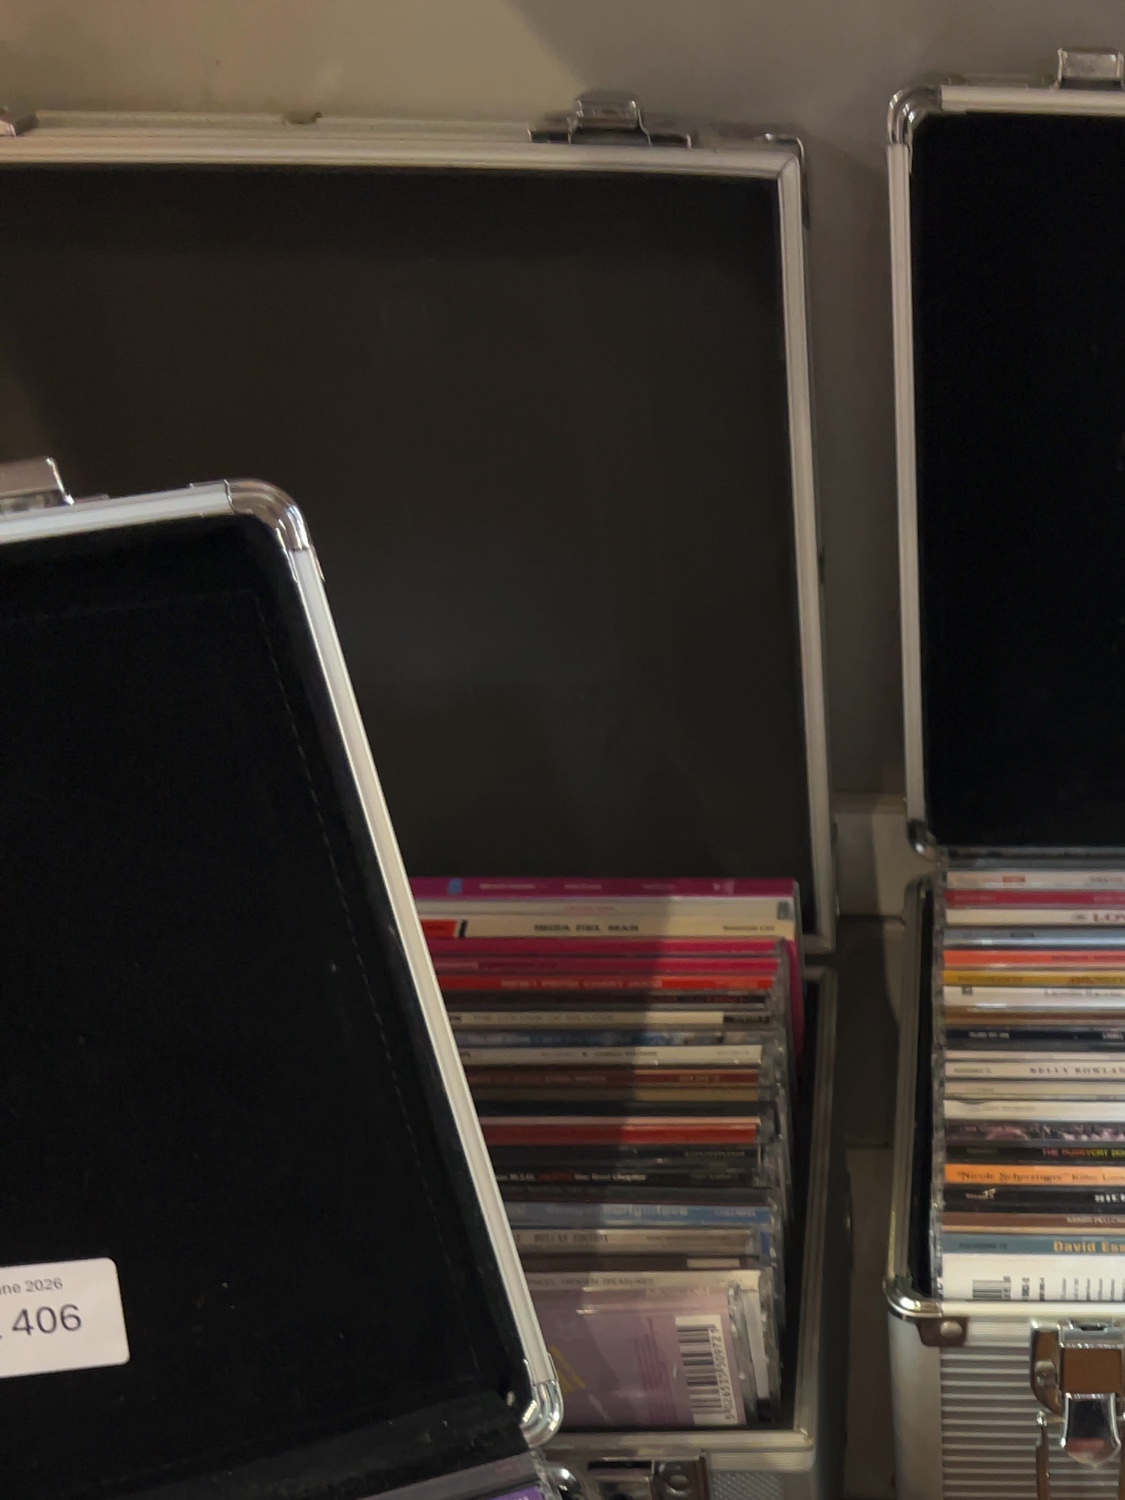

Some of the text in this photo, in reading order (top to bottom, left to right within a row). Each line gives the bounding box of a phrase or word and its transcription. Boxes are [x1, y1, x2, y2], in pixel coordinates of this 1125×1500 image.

[1053, 1240, 1096, 1253] David
[26, 1277, 63, 1292] 2026
[12, 1304, 82, 1336] 406
